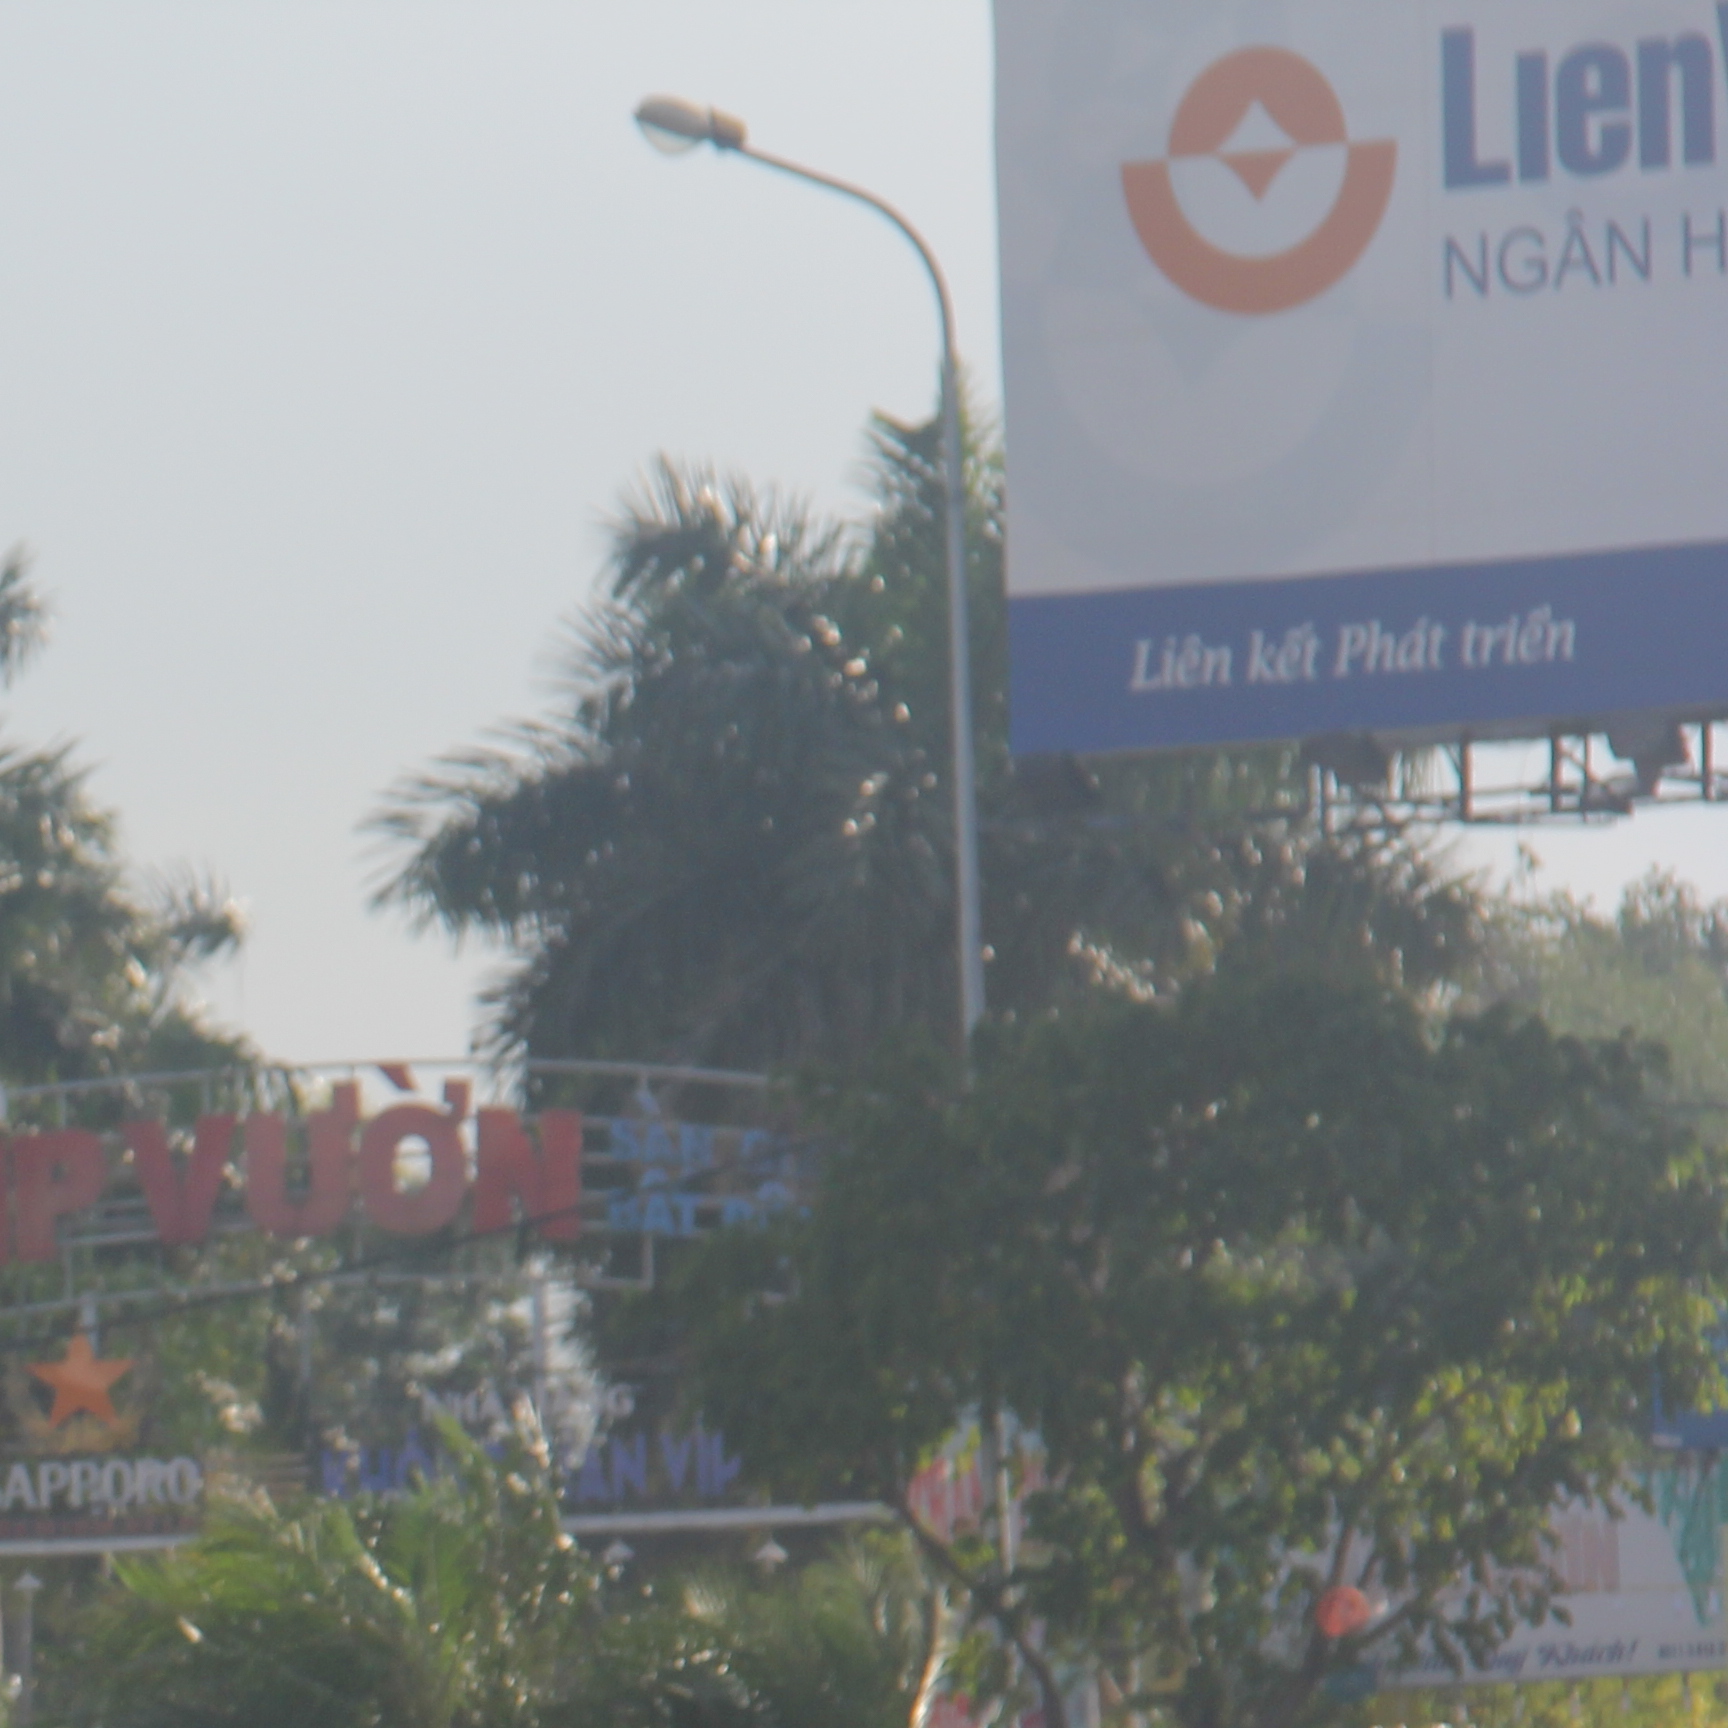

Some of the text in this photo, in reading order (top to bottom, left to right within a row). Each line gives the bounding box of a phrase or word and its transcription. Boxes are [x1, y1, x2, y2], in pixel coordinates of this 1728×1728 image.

[1440, 0, 1728, 190] Lien
[1444, 206, 1652, 300] NGÂN
[1131, 602, 1577, 692] Liên kết Phát triển
